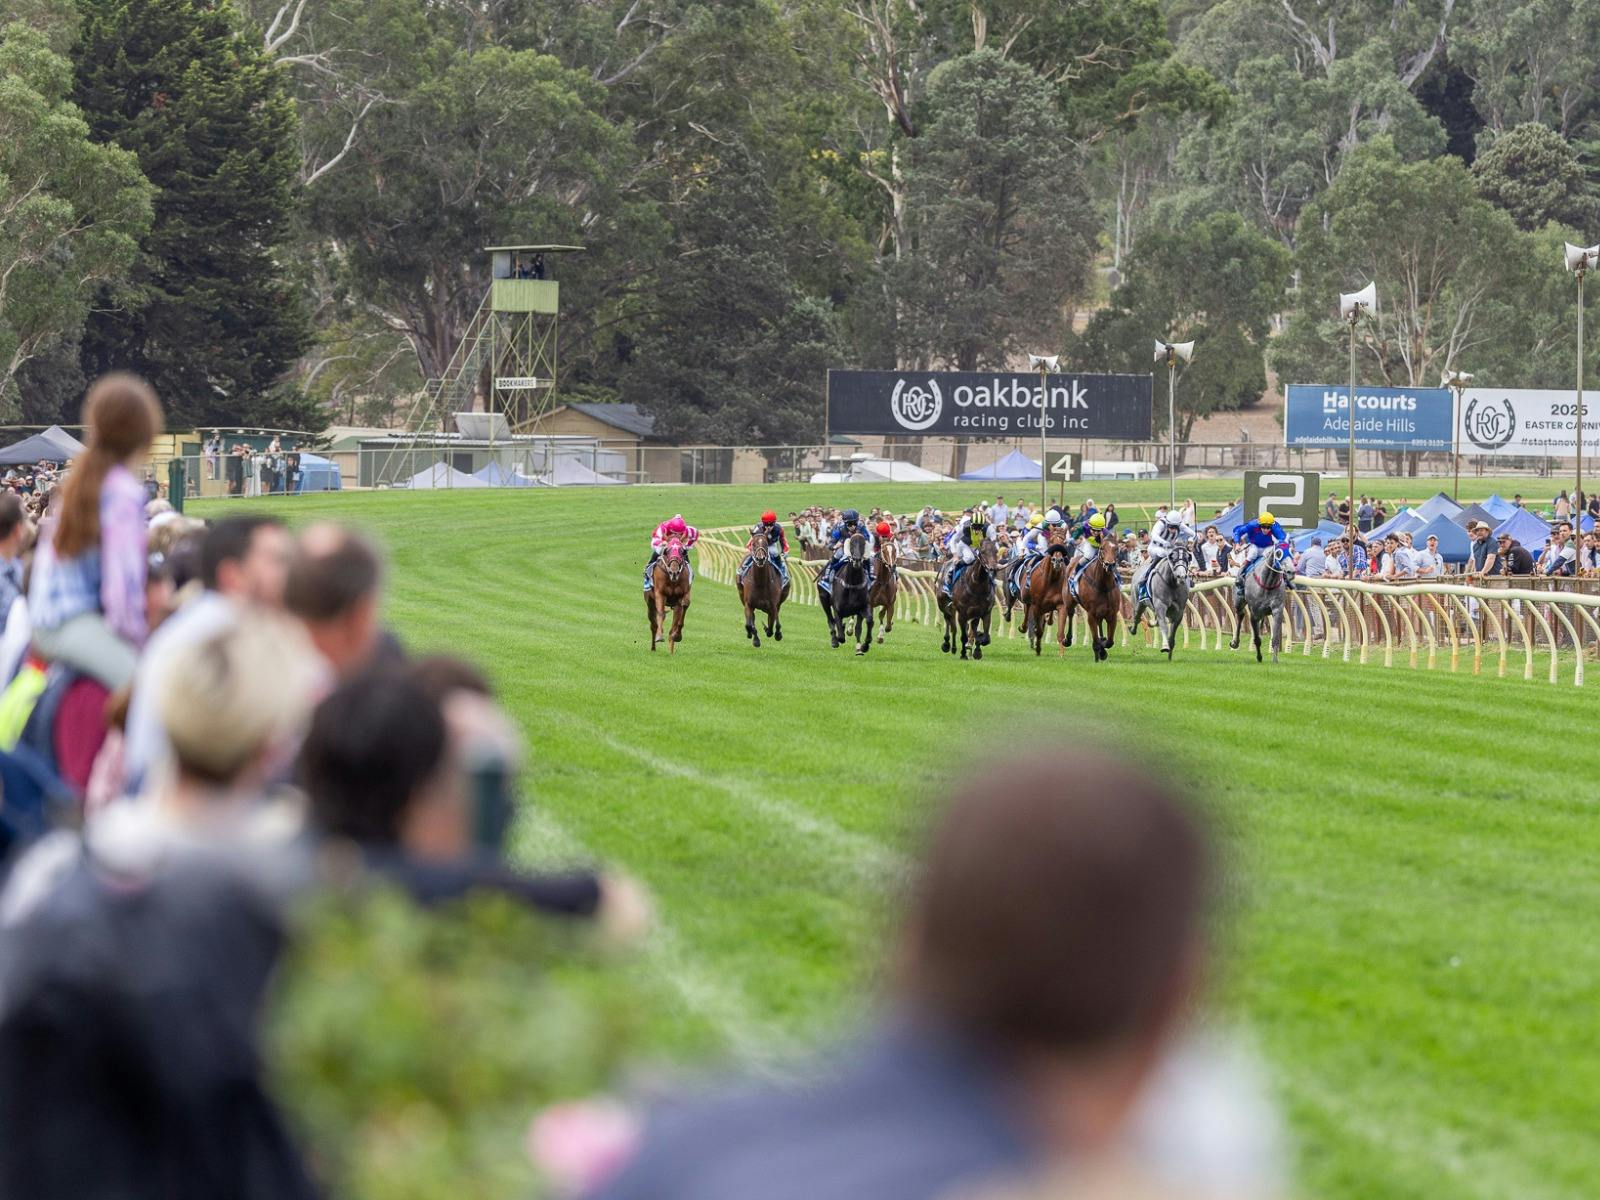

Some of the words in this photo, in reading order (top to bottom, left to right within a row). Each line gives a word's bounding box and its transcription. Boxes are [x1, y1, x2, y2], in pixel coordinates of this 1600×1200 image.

[498, 379, 534, 388] BOOKMAKERS
[953, 378, 1089, 408] oakbank
[1551, 404, 1588, 416] 2025
[953, 413, 1008, 431] racing
[1016, 413, 1055, 428] club
[1063, 415, 1089, 429] inc
[1323, 416, 1383, 431] Adeaide
[1386, 418, 1416, 432] Hills
[1525, 421, 1563, 430] EASTER
[1051, 454, 1075, 481] 4
[1258, 474, 1304, 527] 2
